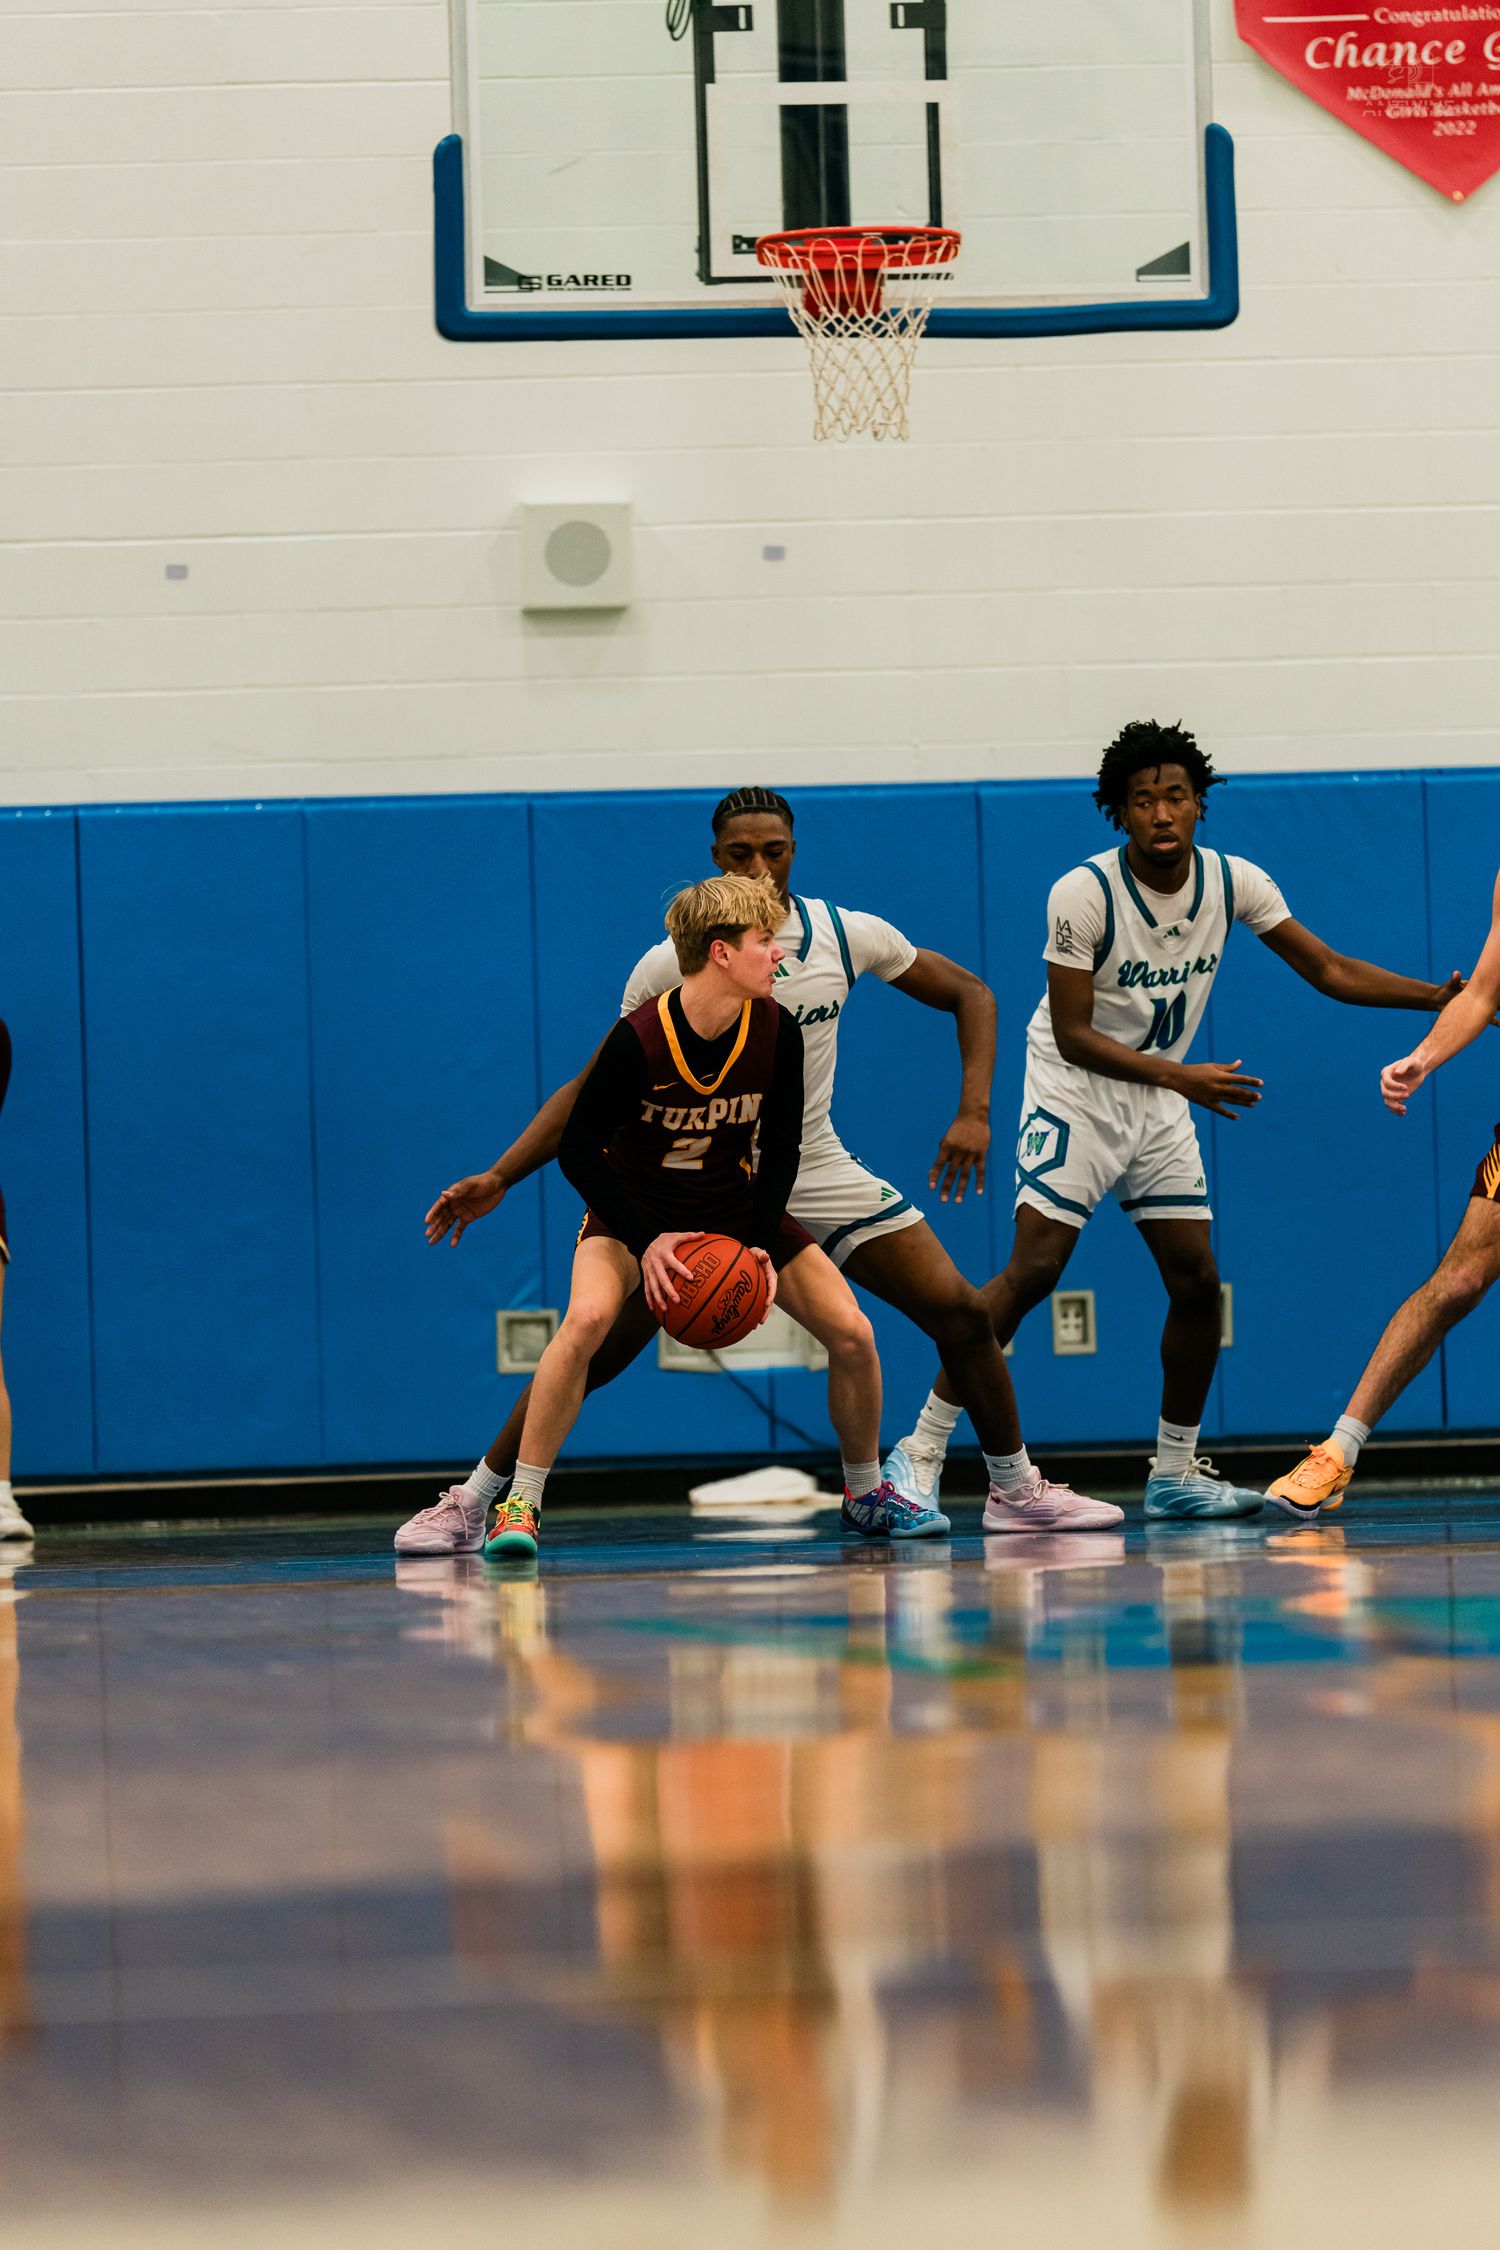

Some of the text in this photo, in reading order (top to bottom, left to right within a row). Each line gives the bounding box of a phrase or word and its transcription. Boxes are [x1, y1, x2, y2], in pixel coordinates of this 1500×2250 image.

[1305, 31, 1466, 69] Chance
[1346, 83, 1445, 101] McDonald's
[1447, 82, 1473, 98] All
[1432, 119, 1477, 136] 2022
[547, 274, 632, 286] GARED
[1117, 953, 1217, 988] Warrirs
[1136, 991, 1187, 1051] 10
[661, 1136, 712, 1170] 2
[711, 1270, 753, 1335] Rawlings
